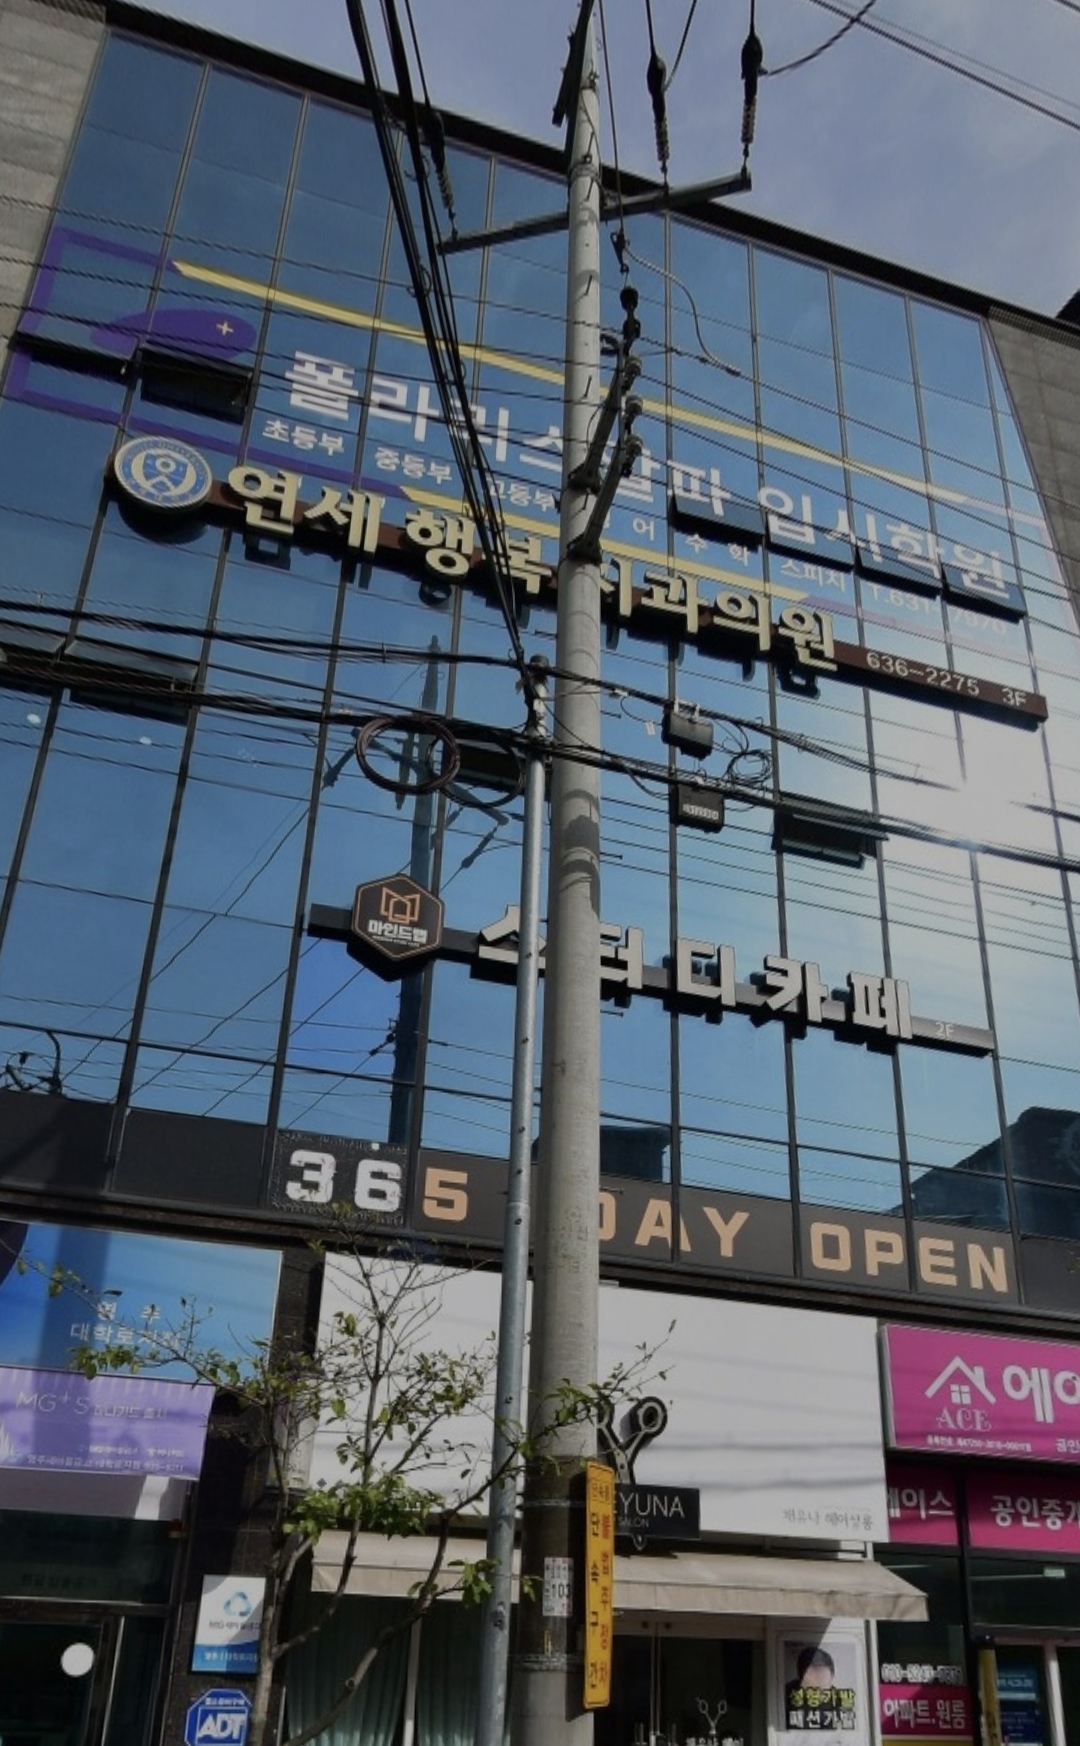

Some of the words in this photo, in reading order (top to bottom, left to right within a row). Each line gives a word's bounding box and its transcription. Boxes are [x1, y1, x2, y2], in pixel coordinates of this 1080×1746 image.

[262, 419, 345, 456] 초등부
[374, 446, 452, 484] 중등부
[866, 652, 980, 697] 636-2275
[1002, 687, 1028, 707] 3F
[286, 1149, 469, 1222] 365
[810, 1221, 1008, 1293] OPEN
[936, 1406, 992, 1432] ACE
[613, 1491, 686, 1519] YUNA
[197, 1712, 247, 1741] ADT
